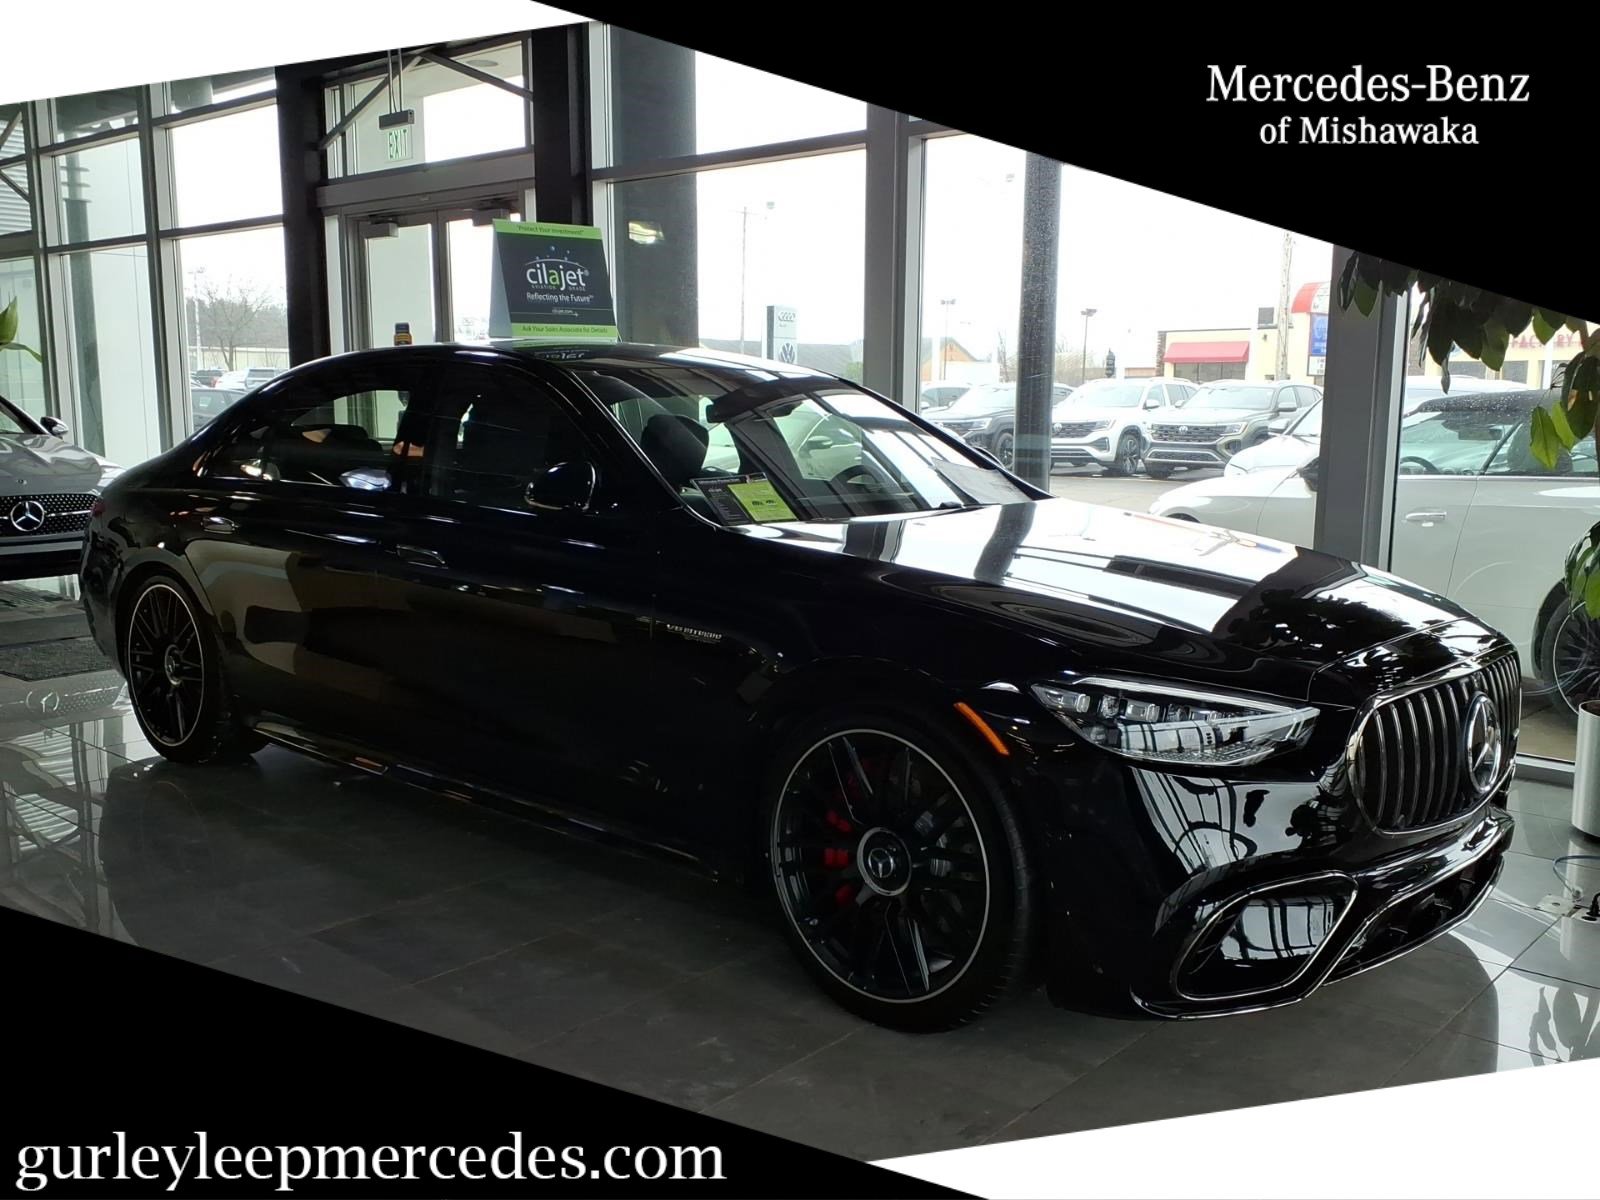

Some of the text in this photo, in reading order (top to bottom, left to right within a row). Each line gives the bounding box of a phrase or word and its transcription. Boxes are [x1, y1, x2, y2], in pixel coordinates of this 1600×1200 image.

[388, 129, 408, 160] EXIT
[526, 291, 559, 303] Reflecting
[559, 293, 570, 302] the
